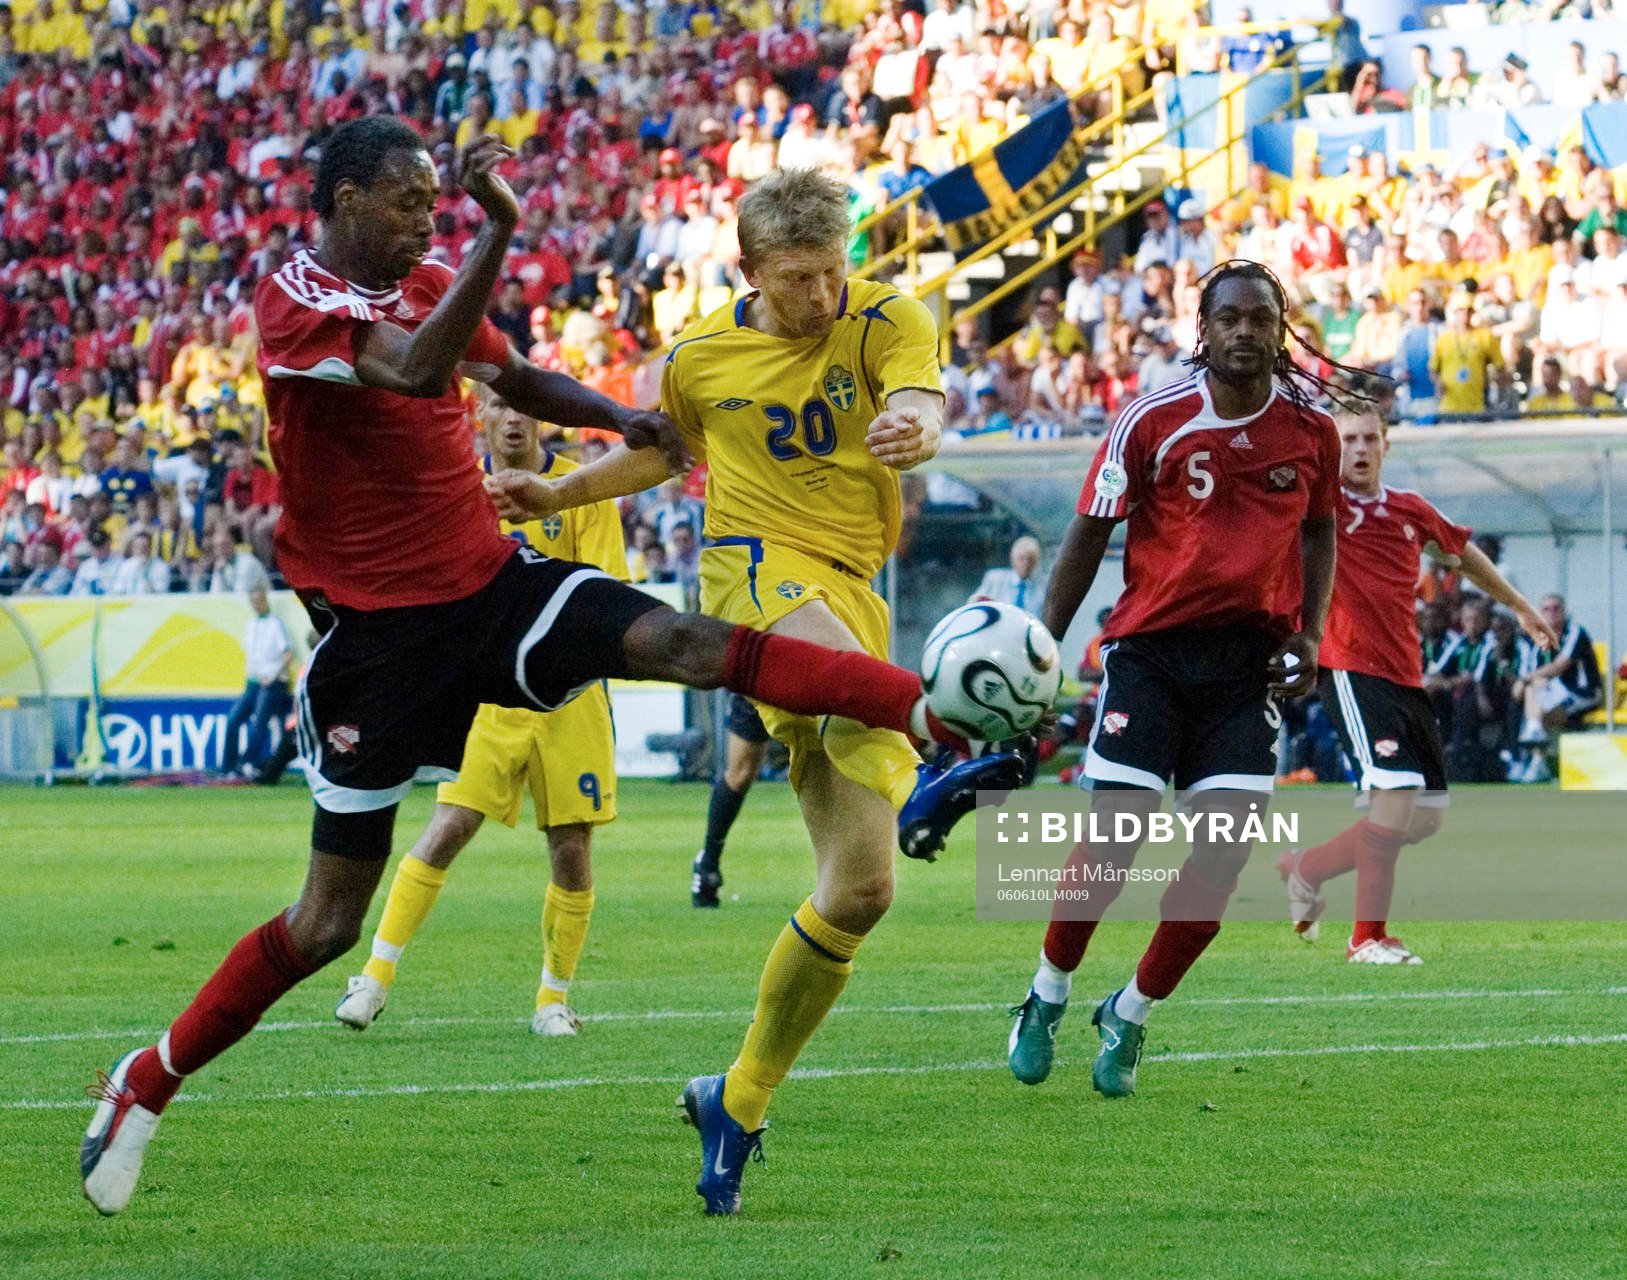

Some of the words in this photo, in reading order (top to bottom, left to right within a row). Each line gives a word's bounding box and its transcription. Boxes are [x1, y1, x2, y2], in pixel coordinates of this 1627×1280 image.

[761, 399, 838, 461] 20
[1187, 451, 1215, 499] 5
[1346, 505, 1364, 535] 7
[578, 772, 601, 812] 9
